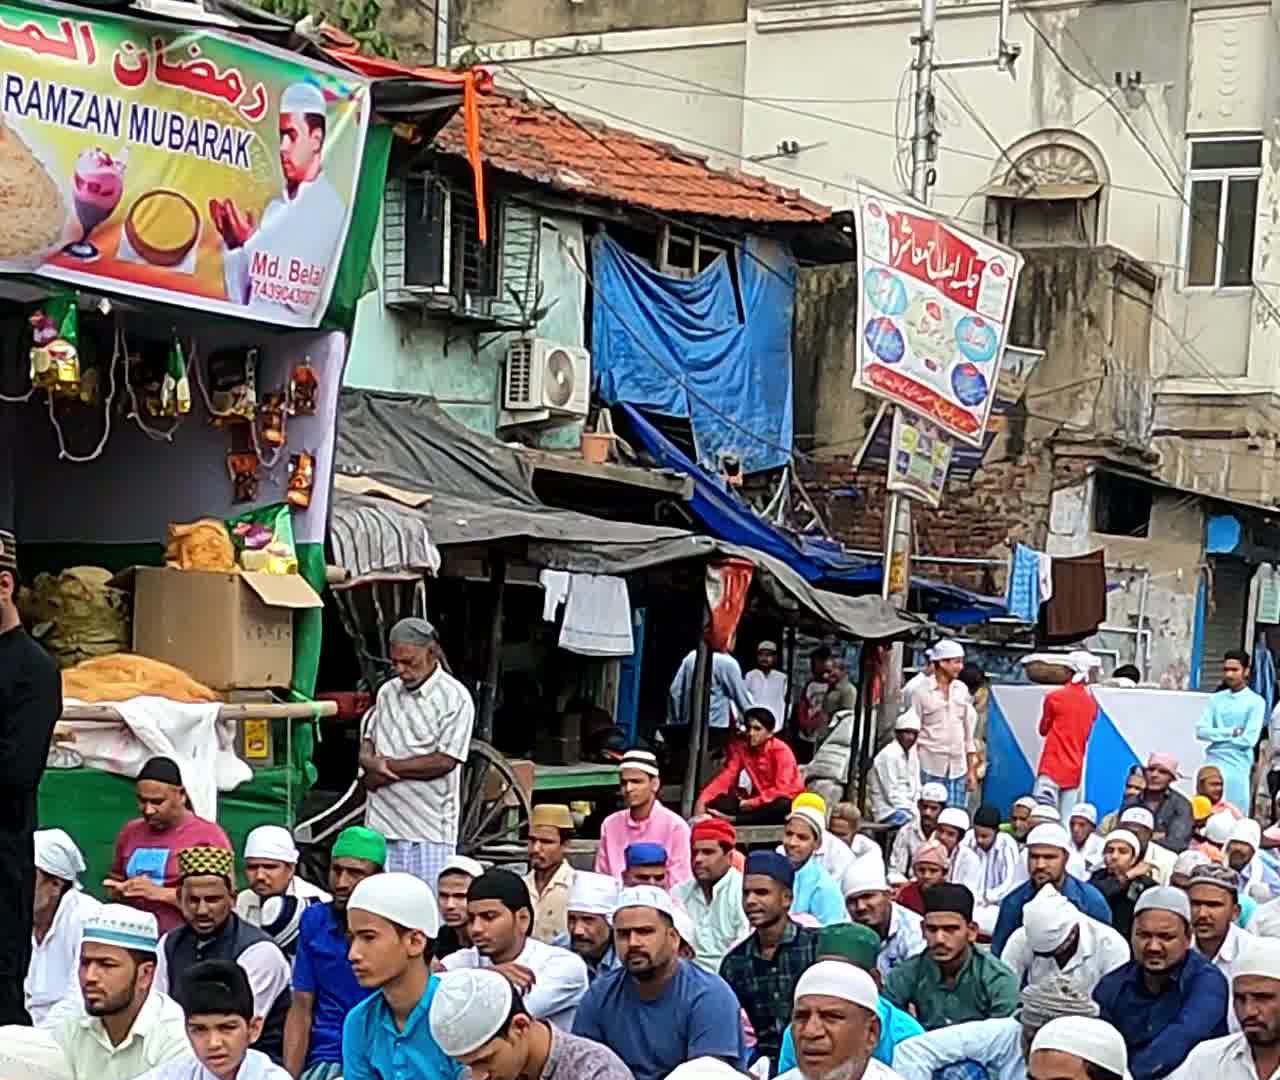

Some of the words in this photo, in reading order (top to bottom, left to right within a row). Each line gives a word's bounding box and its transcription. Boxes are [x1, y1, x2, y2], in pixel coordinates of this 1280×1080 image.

[113, 36, 267, 119] رمضان
[4, 74, 122, 137] RAMZAN
[129, 104, 254, 168] MUBARAK
[252, 251, 282, 280] Md.
